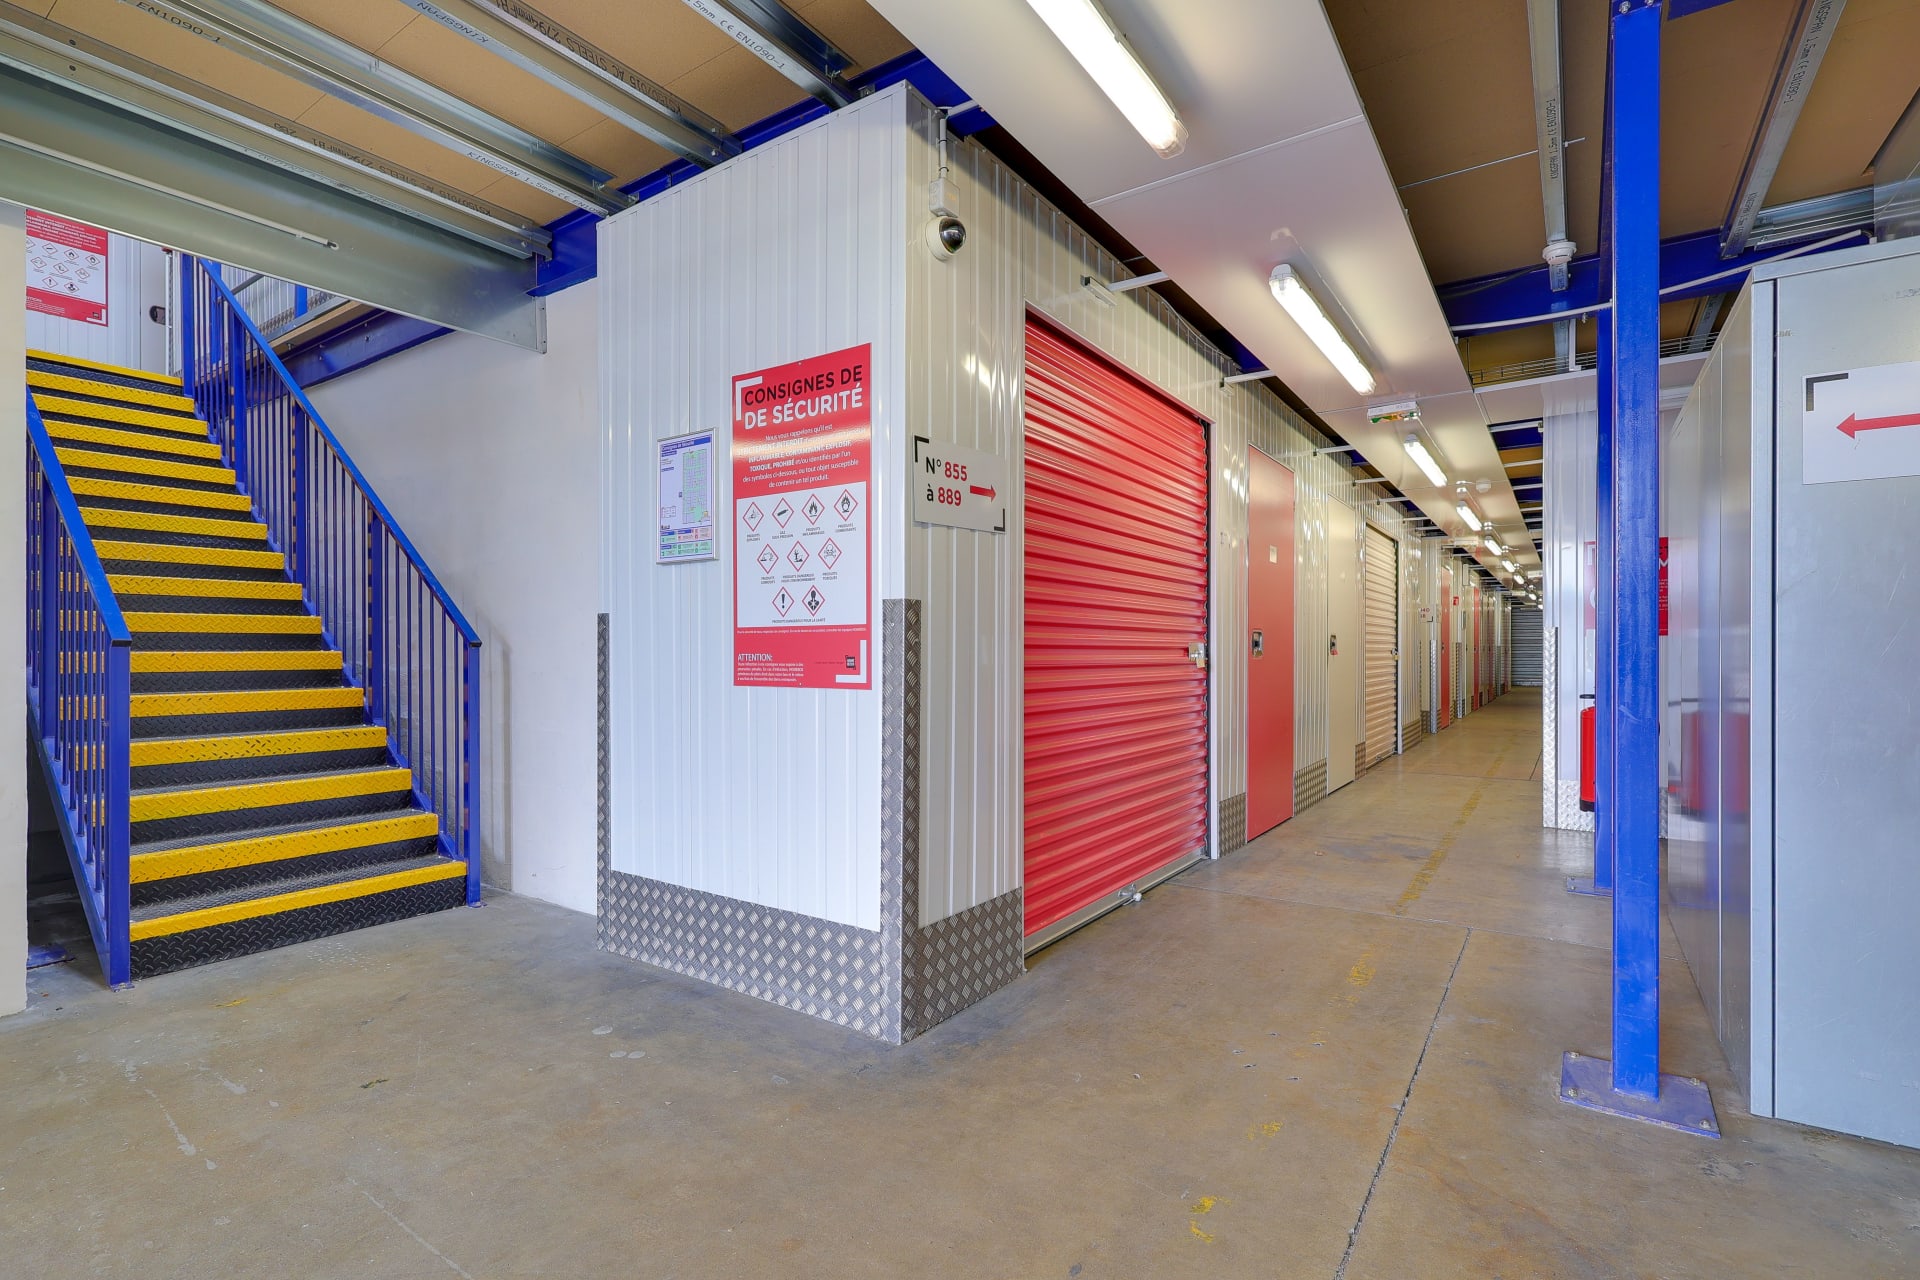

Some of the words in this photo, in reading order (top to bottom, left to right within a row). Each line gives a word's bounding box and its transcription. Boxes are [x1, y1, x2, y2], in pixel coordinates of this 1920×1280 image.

[136, 2, 221, 43] EN1090-1
[417, 2, 488, 43] KINGSPAN
[566, 37, 608, 72] STEELS
[735, 31, 786, 70] EN1090-1
[1547, 98, 1557, 127] EN1090-1
[467, 151, 520, 178] KINGSPAN
[744, 371, 835, 406] CONSIGNES
[840, 365, 863, 385] DE
[744, 408, 768, 430] DE
[772, 383, 863, 424] SÉCURITÉ
[926, 456, 941, 474] N°
[945, 461, 968, 481] 855
[926, 483, 934, 502] à
[938, 486, 962, 506] 889
